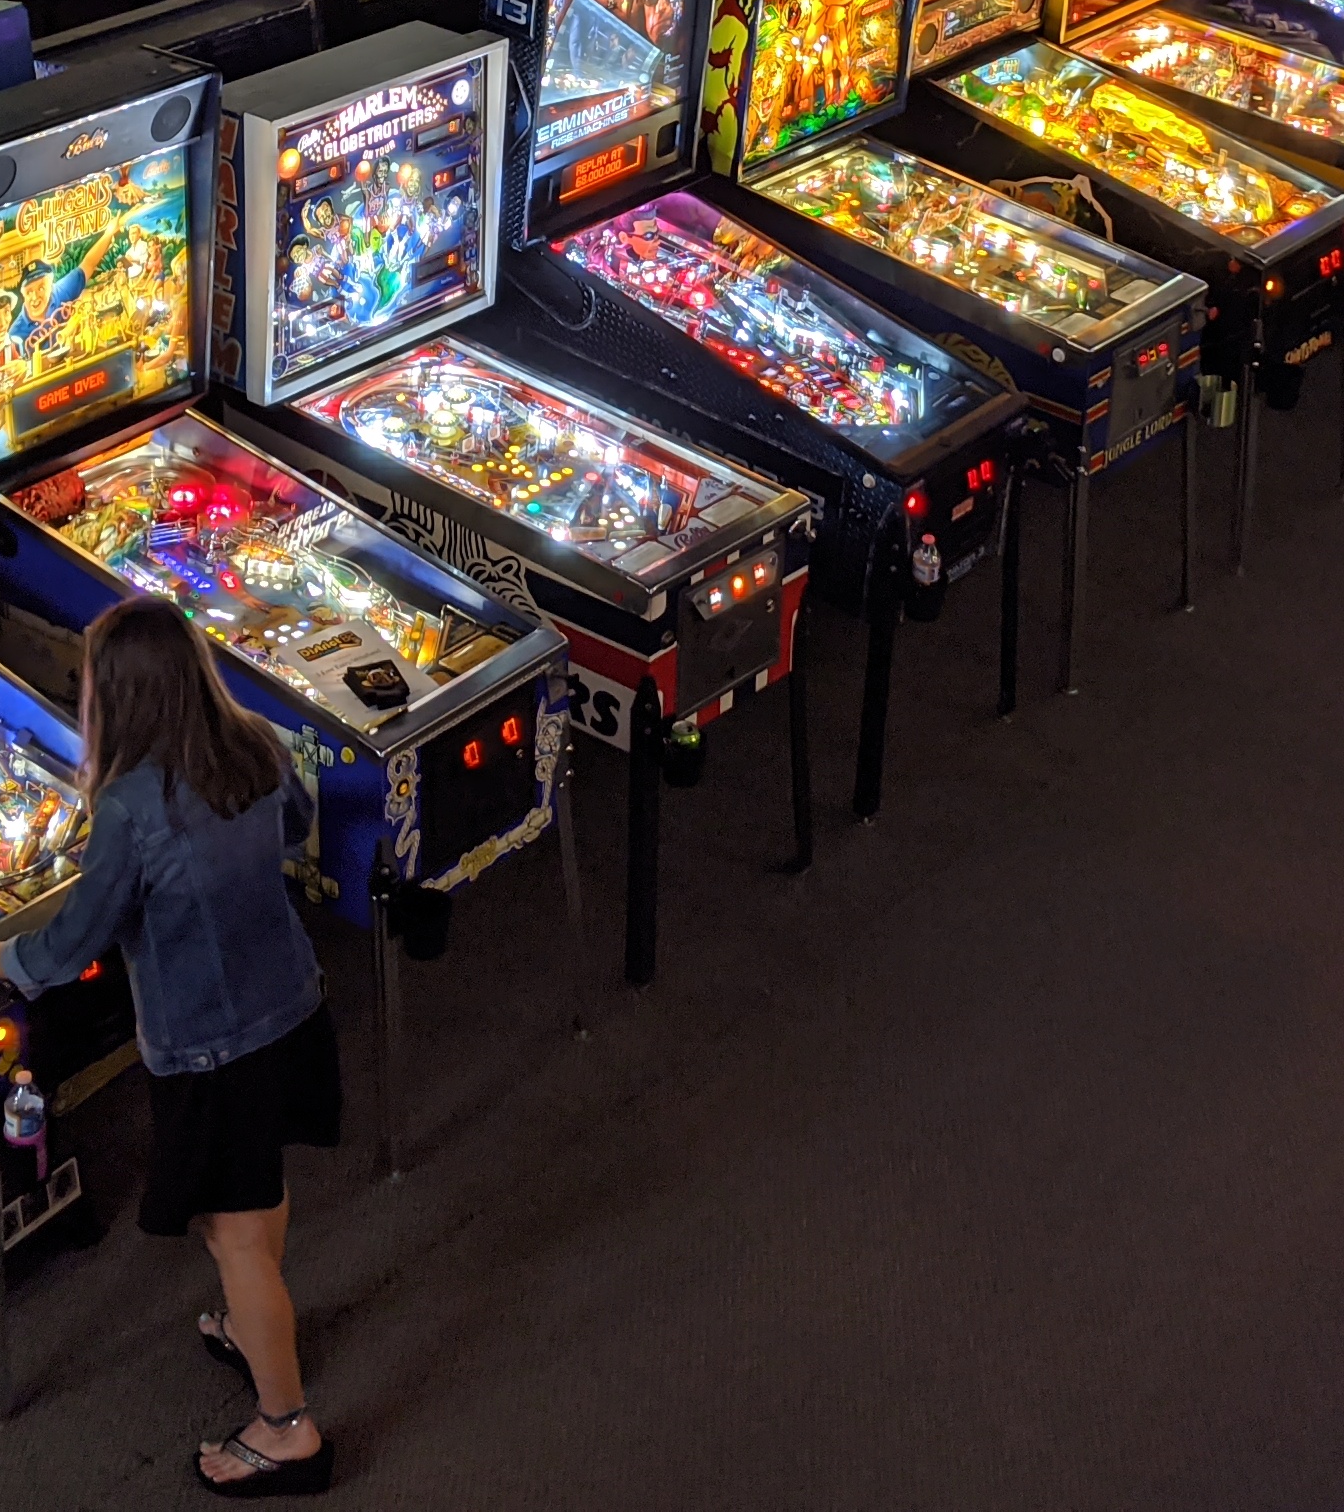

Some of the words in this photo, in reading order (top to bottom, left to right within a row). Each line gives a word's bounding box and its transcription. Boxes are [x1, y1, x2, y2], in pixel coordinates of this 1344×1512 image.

[338, 84, 419, 137] HARLEM
[537, 91, 635, 142] ERMINATOR
[551, 132, 574, 150] RISE
[578, 110, 629, 137] MACHINES
[61, 128, 109, 159] Bally
[297, 128, 322, 153] Bally
[323, 106, 434, 162] GLOBETROTTERS
[363, 148, 375, 160] ON
[375, 140, 396, 157] TOUR
[143, 160, 172, 180] Bally
[575, 153, 607, 177] REPLAY
[610, 146, 625, 162] AT
[44, 205, 112, 260] ISLAND
[37, 386, 71, 410] GAME
[74, 371, 105, 395] OVER
[1104, 429, 1143, 468] JUNGLE
[1144, 411, 1174, 439] LORD
